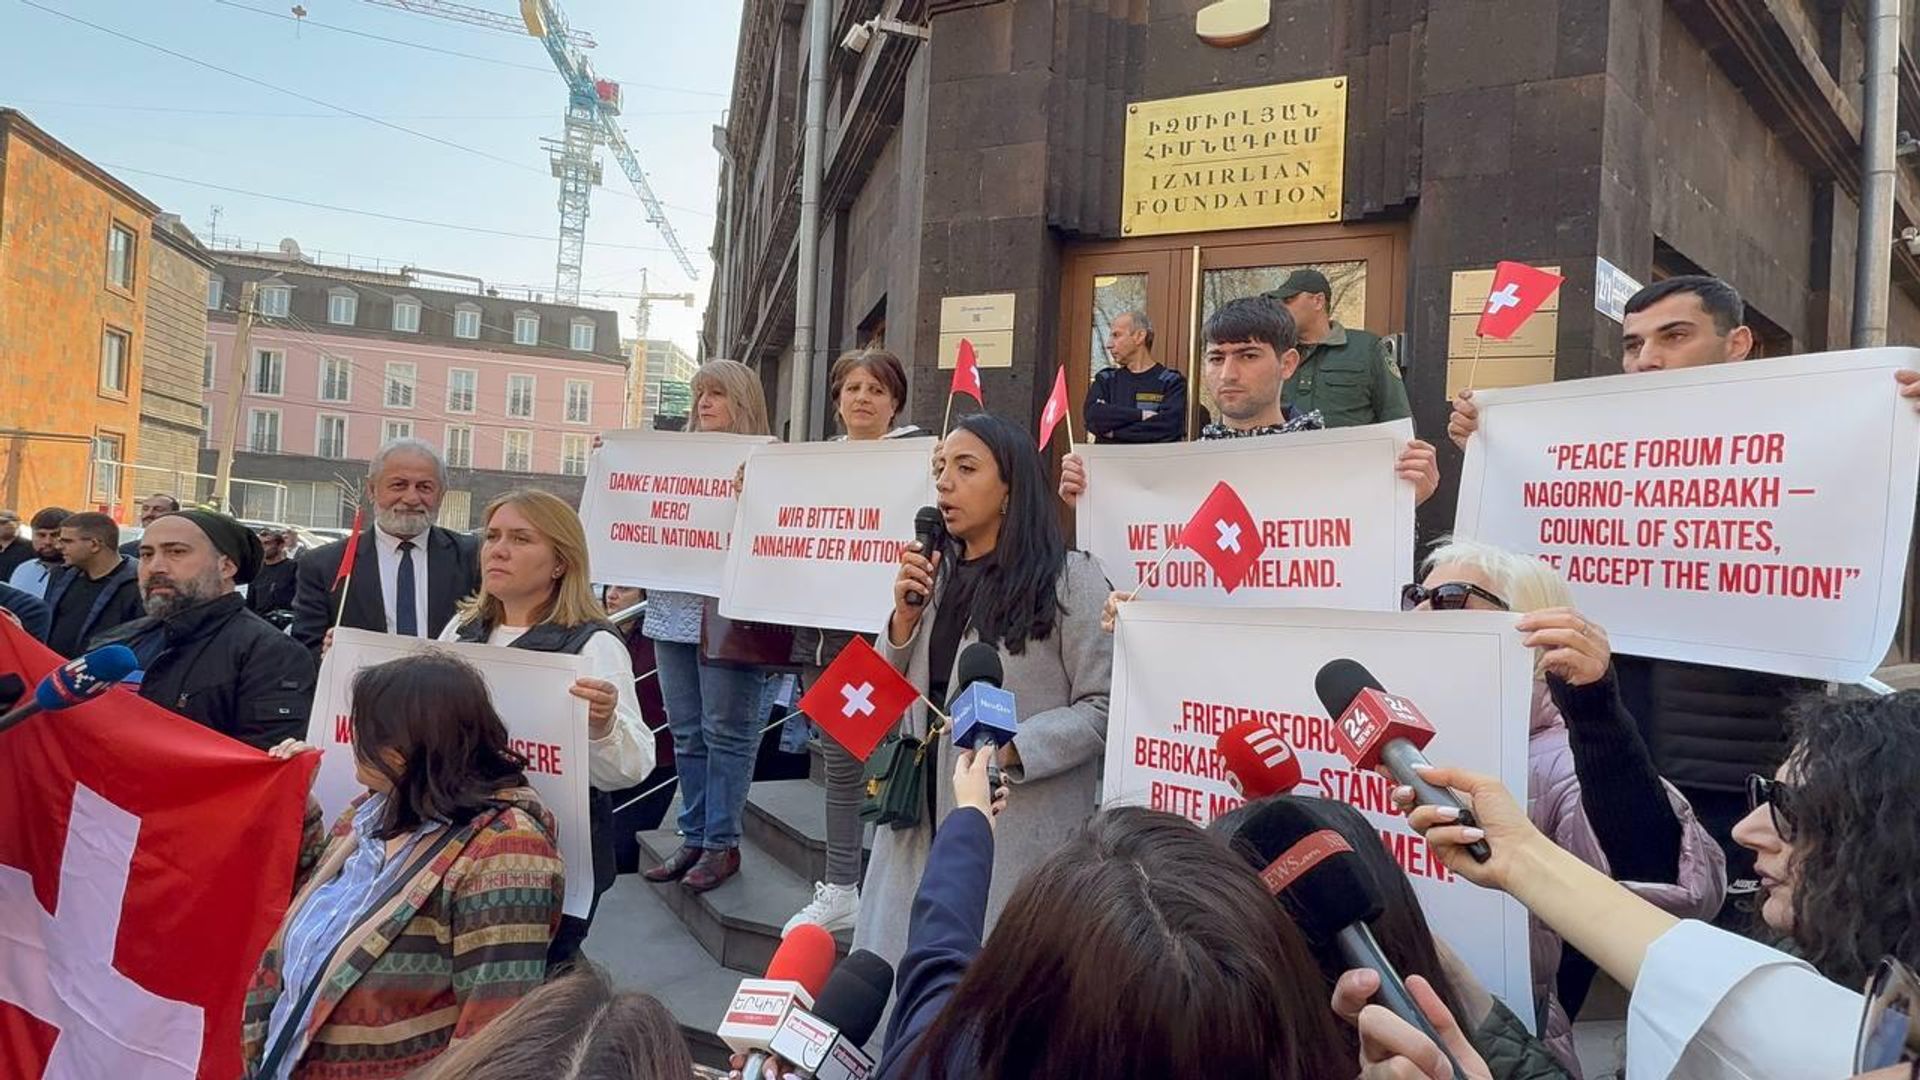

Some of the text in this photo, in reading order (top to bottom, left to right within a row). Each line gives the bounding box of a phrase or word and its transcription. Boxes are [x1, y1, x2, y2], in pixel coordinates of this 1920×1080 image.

[1149, 104, 1319, 136] ԻԶՄԻՐԼՅԱՆ
[1144, 127, 1322, 160] ՀԻՄՆԱԳՐԱՄ
[1151, 160, 1311, 191] IZMIRLIAN
[1136, 185, 1327, 215] FOUNDATION
[1547, 433, 1785, 470] “PEACE FORUM FOR
[609, 472, 734, 498] DANKE NATIONALRAT
[1523, 477, 1780, 508] NAGORNO-KARABAKH
[650, 501, 690, 521] MERCI
[778, 506, 880, 531] WIR BITTEN UM
[610, 522, 658, 545] CONSEIL
[661, 527, 723, 550] NATIONAL
[752, 535, 815, 559] ANNAHME
[816, 537, 845, 561] DER
[1128, 524, 1157, 550] WE
[1263, 517, 1351, 548] RETURN
[1540, 518, 1781, 555] COUNCIL OF STATES,
[1136, 561, 1159, 588] TO
[1166, 560, 1206, 588] OUR
[1567, 555, 1654, 587] ACCEPT
[1661, 559, 1709, 591] THE
[1718, 562, 1861, 600] MOTION!”
[1344, 708, 1370, 740] 24
[1151, 781, 1203, 822] BITTE
